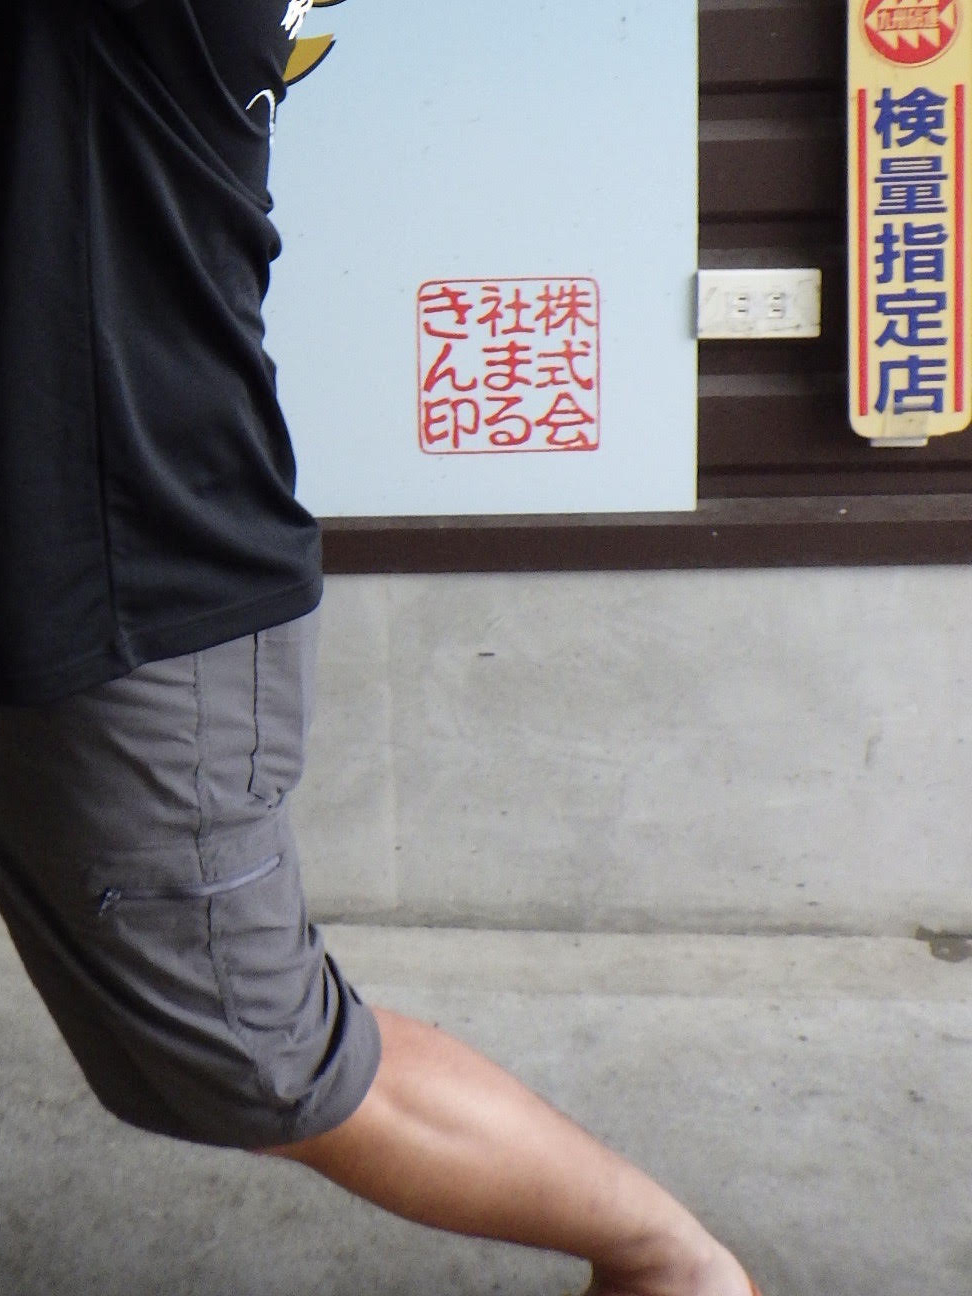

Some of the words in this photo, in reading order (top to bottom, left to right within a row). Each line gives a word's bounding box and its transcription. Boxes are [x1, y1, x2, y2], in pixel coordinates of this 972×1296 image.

[874, 87, 948, 416] 検量指定店
